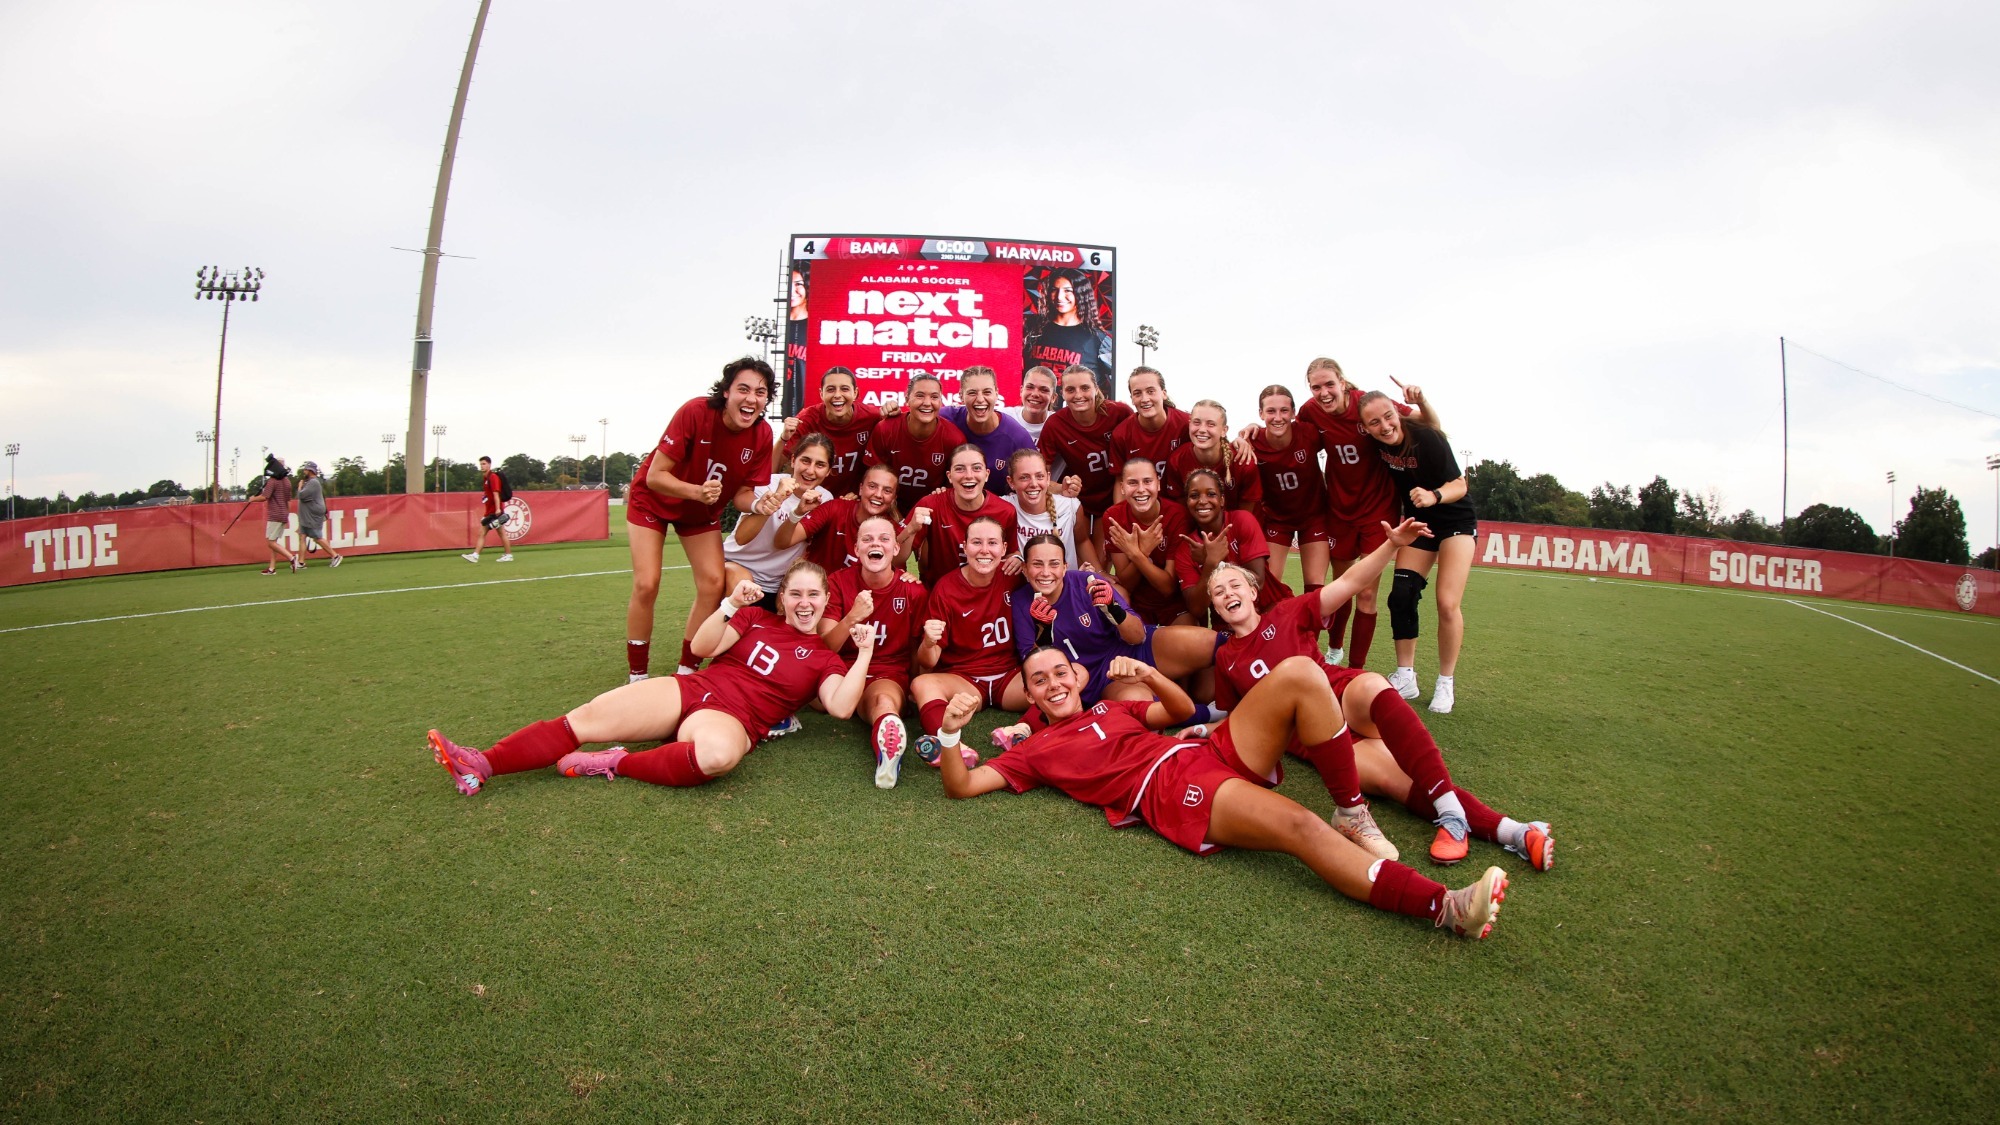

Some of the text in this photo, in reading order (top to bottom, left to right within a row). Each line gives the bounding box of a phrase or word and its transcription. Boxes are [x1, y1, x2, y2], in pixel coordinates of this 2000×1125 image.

[803, 241, 816, 255] 4
[850, 241, 899, 254] BAMA
[936, 240, 975, 253] 0:00
[995, 246, 1075, 263] HARVARD
[1090, 252, 1101, 266] 6
[861, 276, 970, 286] ALABAMA SOCCER
[848, 288, 983, 317] next
[819, 317, 1008, 349] match
[881, 351, 946, 364] FRIDAY
[855, 368, 904, 380] SEPT
[832, 450, 858, 473] 47
[1086, 450, 1110, 473] 21
[1335, 444, 1360, 465] 18
[898, 465, 928, 488] 22
[1276, 471, 1299, 491] 10
[276, 508, 379, 552] RLL
[24, 523, 119, 574] TIDE
[1482, 532, 1652, 576] ALABAMA
[1709, 550, 1823, 592] SOCCER
[865, 620, 887, 646] 4
[981, 616, 1010, 648] 20
[746, 640, 780, 676] 13
[1063, 638, 1079, 660] 1
[1078, 721, 1107, 740] 7
